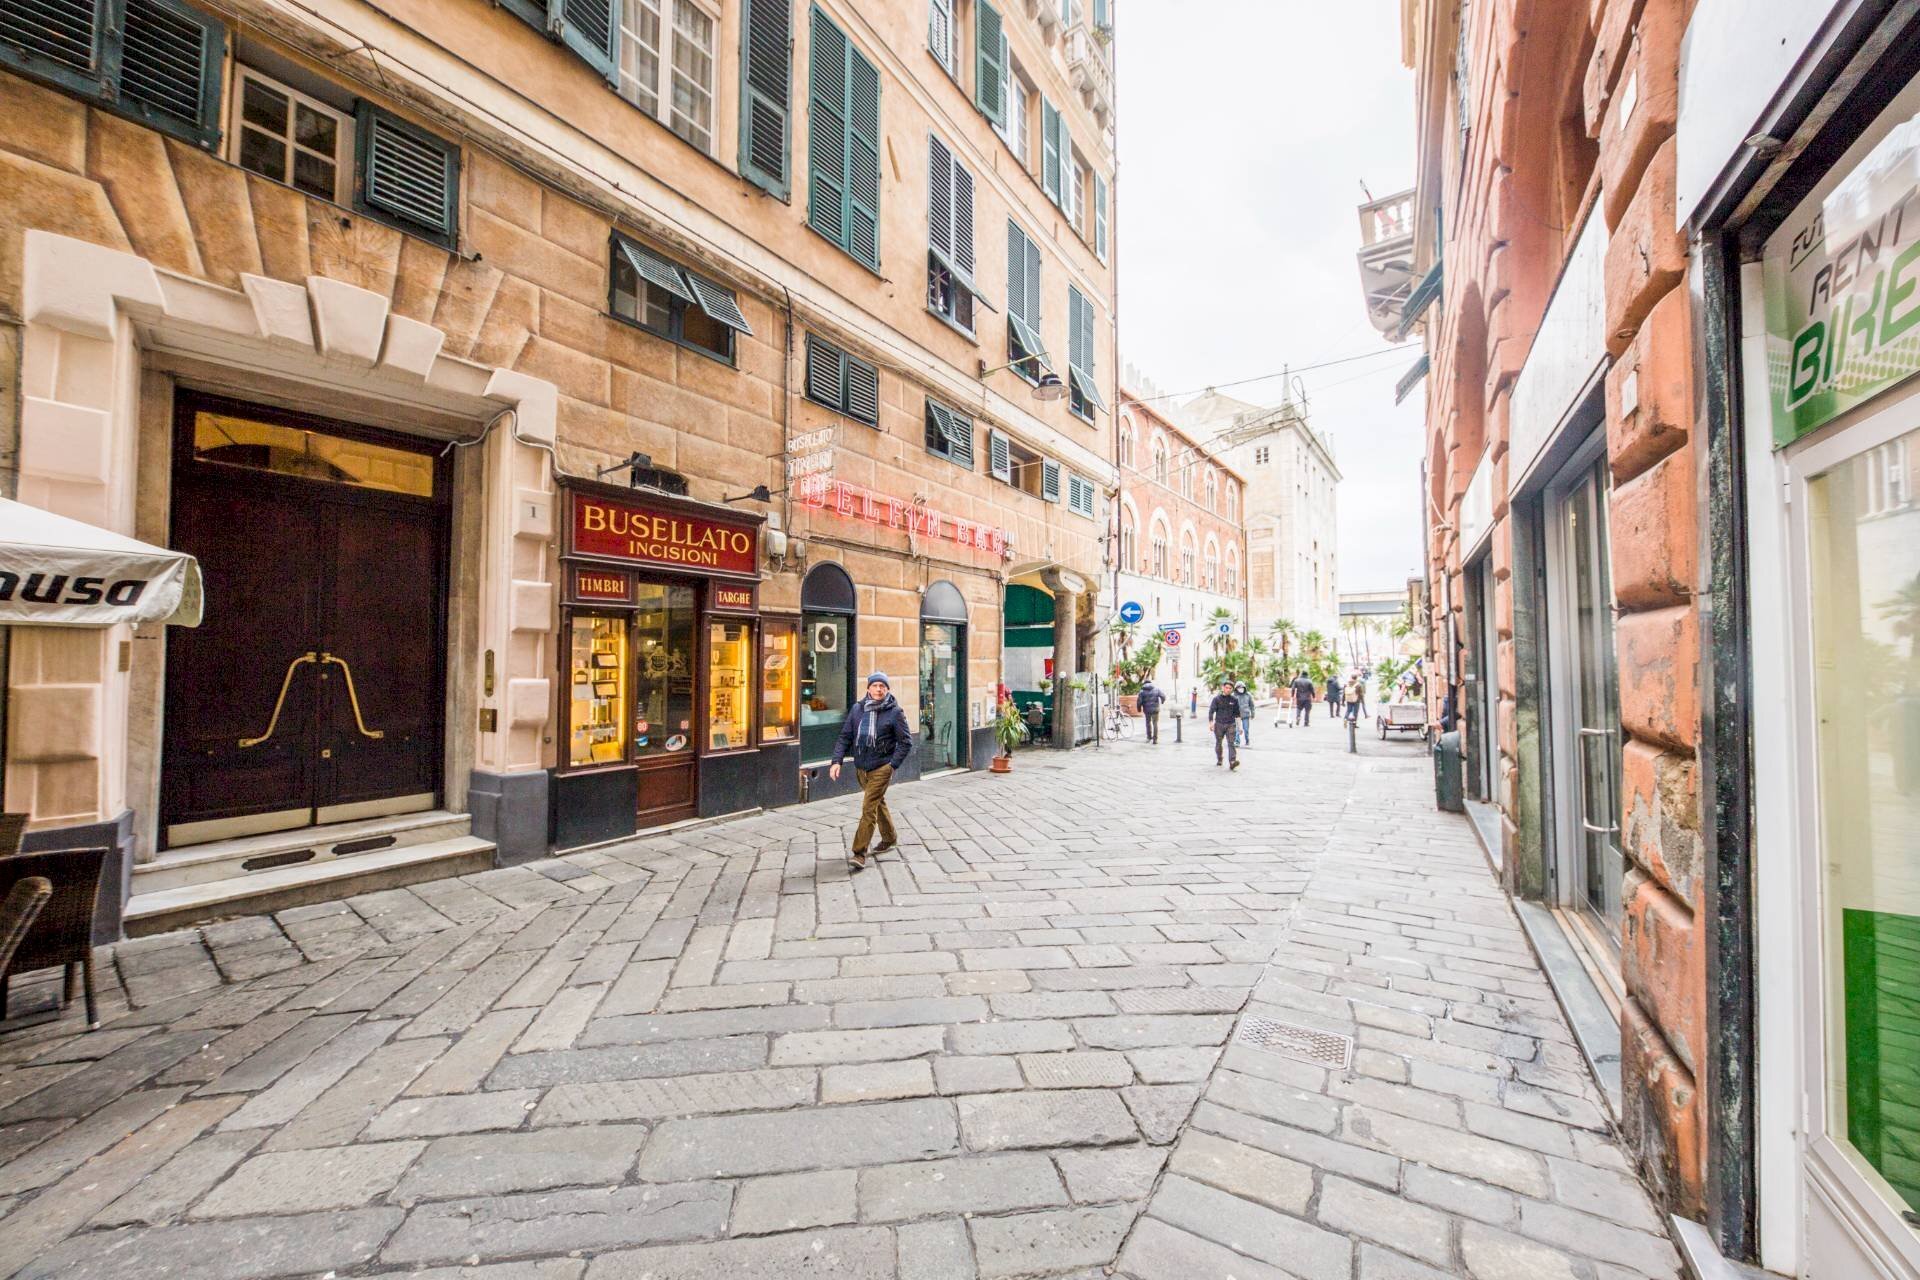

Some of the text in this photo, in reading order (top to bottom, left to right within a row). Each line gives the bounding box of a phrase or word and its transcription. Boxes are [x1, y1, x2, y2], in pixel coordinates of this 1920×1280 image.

[1810, 184, 1918, 316] RENT
[1788, 238, 1920, 404] BIKE
[583, 504, 751, 554] BUSELLATO
[956, 519, 1004, 555] BAR
[628, 540, 718, 566] INCISIONI
[579, 577, 625, 594] TIMBRI
[717, 590, 751, 605] TARGHE
